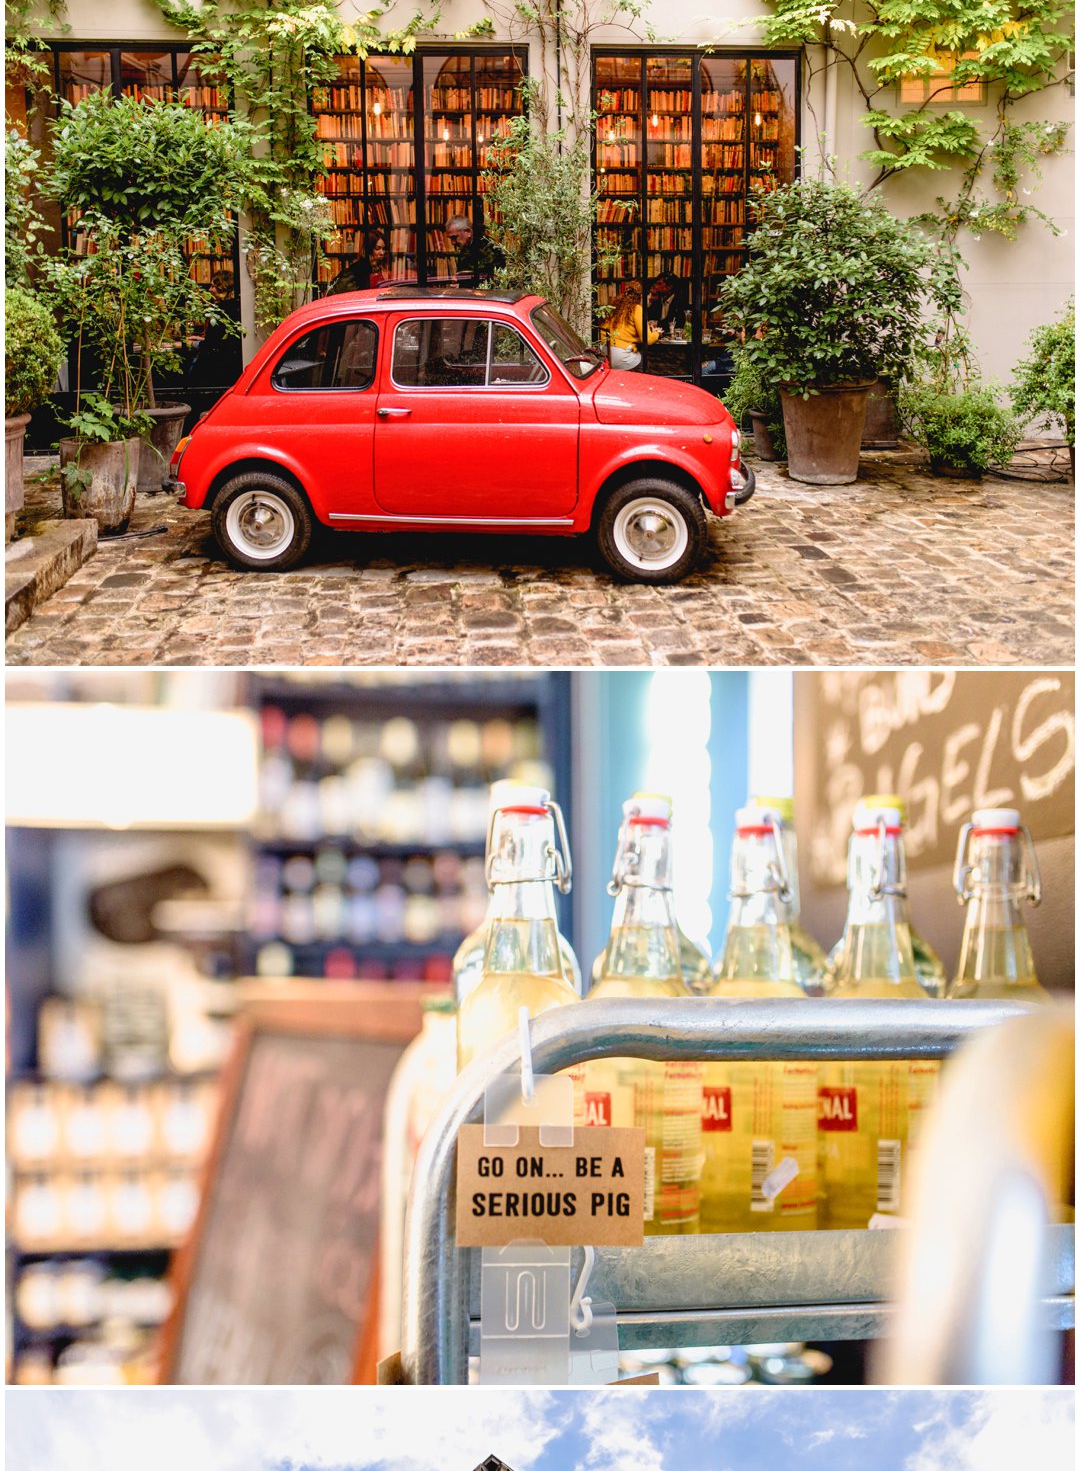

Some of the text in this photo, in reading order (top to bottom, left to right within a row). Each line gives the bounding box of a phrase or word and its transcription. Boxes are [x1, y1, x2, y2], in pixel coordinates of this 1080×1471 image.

[478, 1157, 624, 1177] GO ON... BE A
[472, 1193, 630, 1216] SERIOUS PIG
